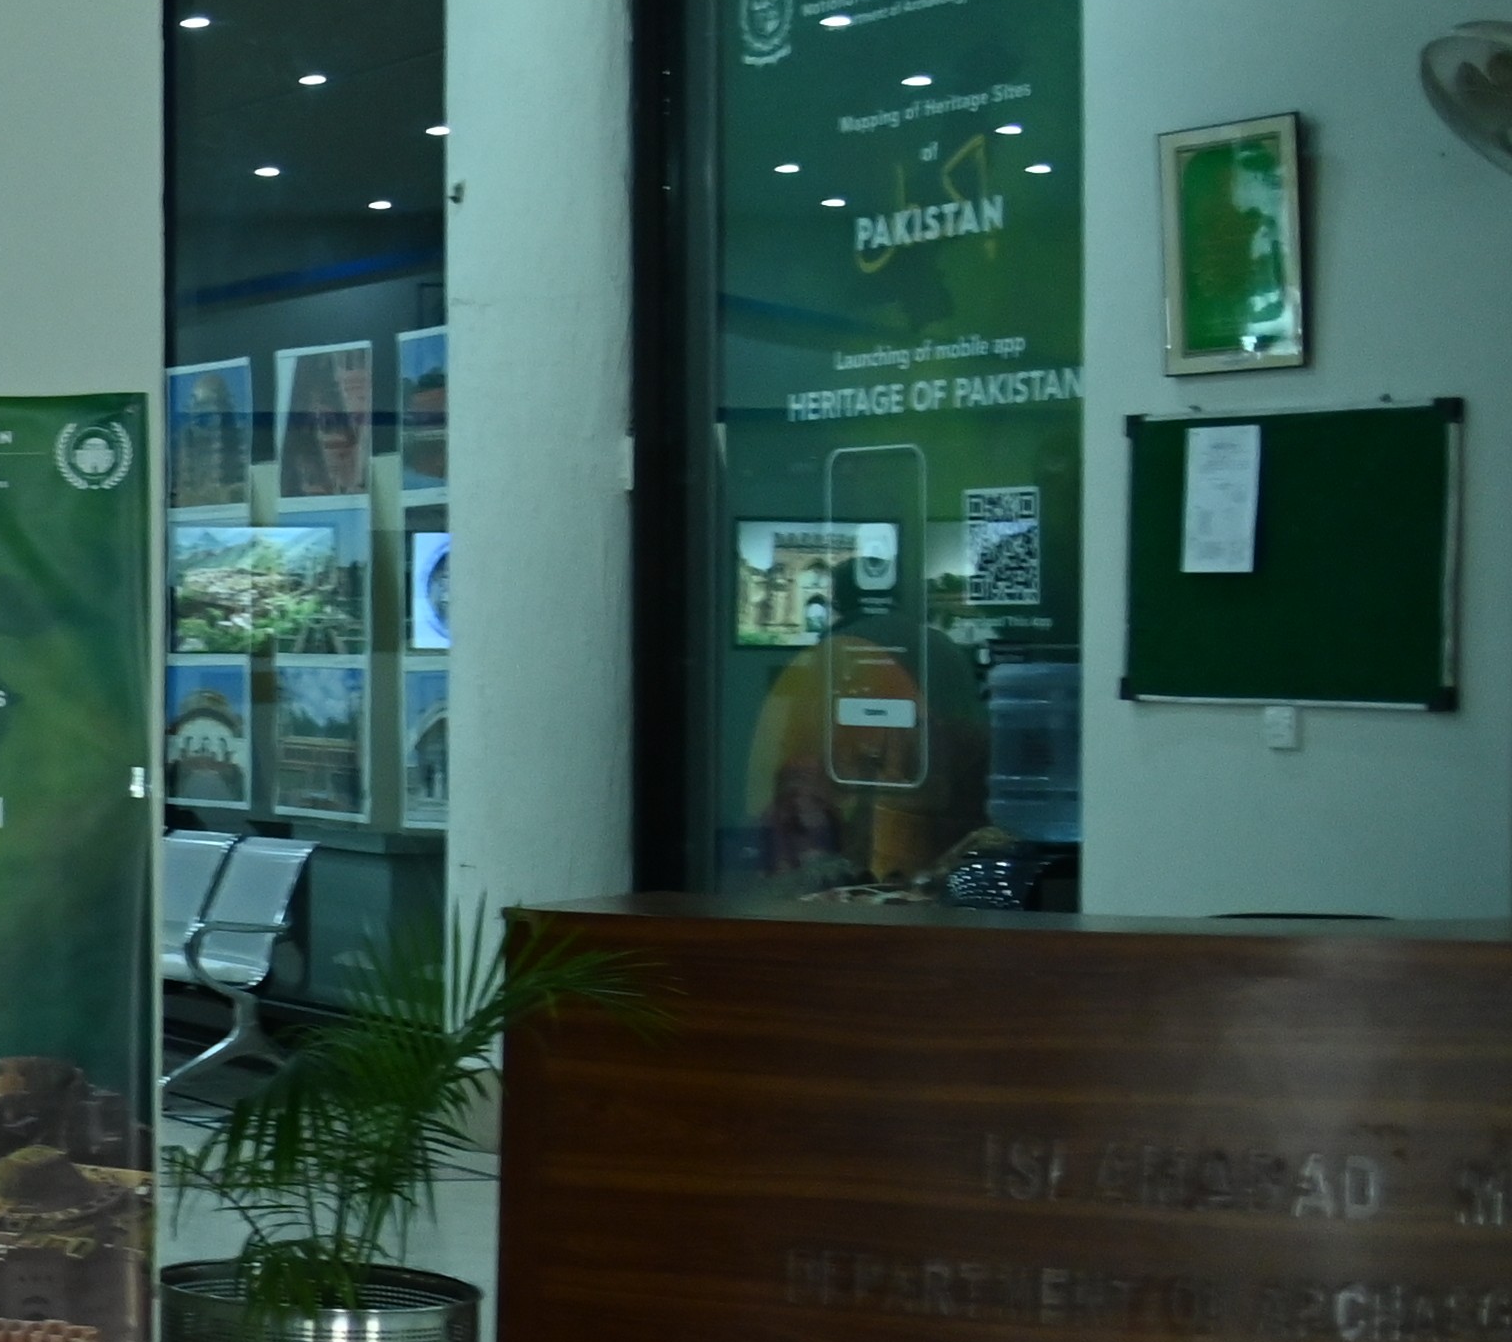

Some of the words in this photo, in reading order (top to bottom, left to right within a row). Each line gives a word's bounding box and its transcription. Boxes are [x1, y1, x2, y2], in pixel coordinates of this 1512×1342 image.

[838, 110, 900, 133] Mapping
[905, 102, 920, 121] of
[923, 92, 988, 115] Heritage
[991, 83, 1032, 103] Sites
[920, 141, 939, 161] of
[854, 195, 1004, 251] PAKISTAN
[834, 345, 911, 371] Launching
[914, 339, 932, 362] of
[934, 335, 989, 359] mobile
[993, 337, 1026, 359] app
[787, 383, 905, 422] HERITAGE
[911, 379, 947, 411] OF
[954, 366, 1084, 407] PAKISTAN
